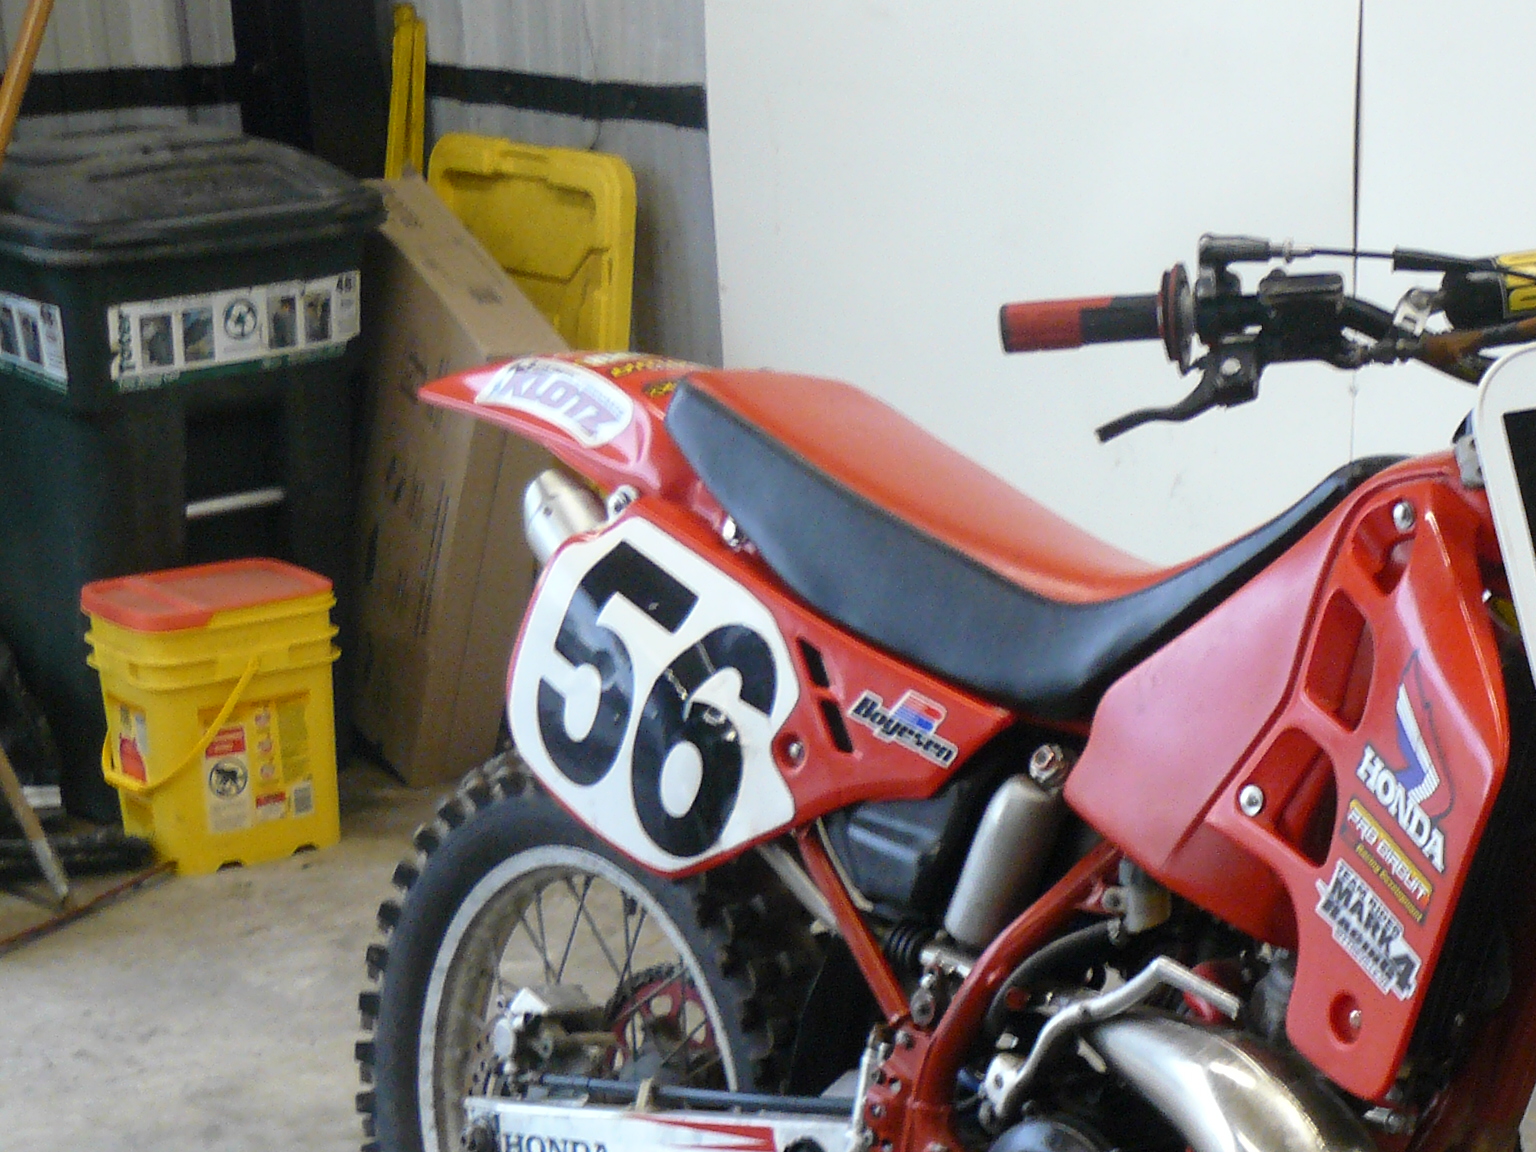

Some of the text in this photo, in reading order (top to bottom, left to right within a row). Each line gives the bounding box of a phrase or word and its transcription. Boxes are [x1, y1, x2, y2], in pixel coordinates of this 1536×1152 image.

[498, 370, 620, 435] KLOTZ
[536, 540, 778, 858] 56
[1356, 744, 1445, 874] HONDA
[1330, 879, 1394, 957] MARK
